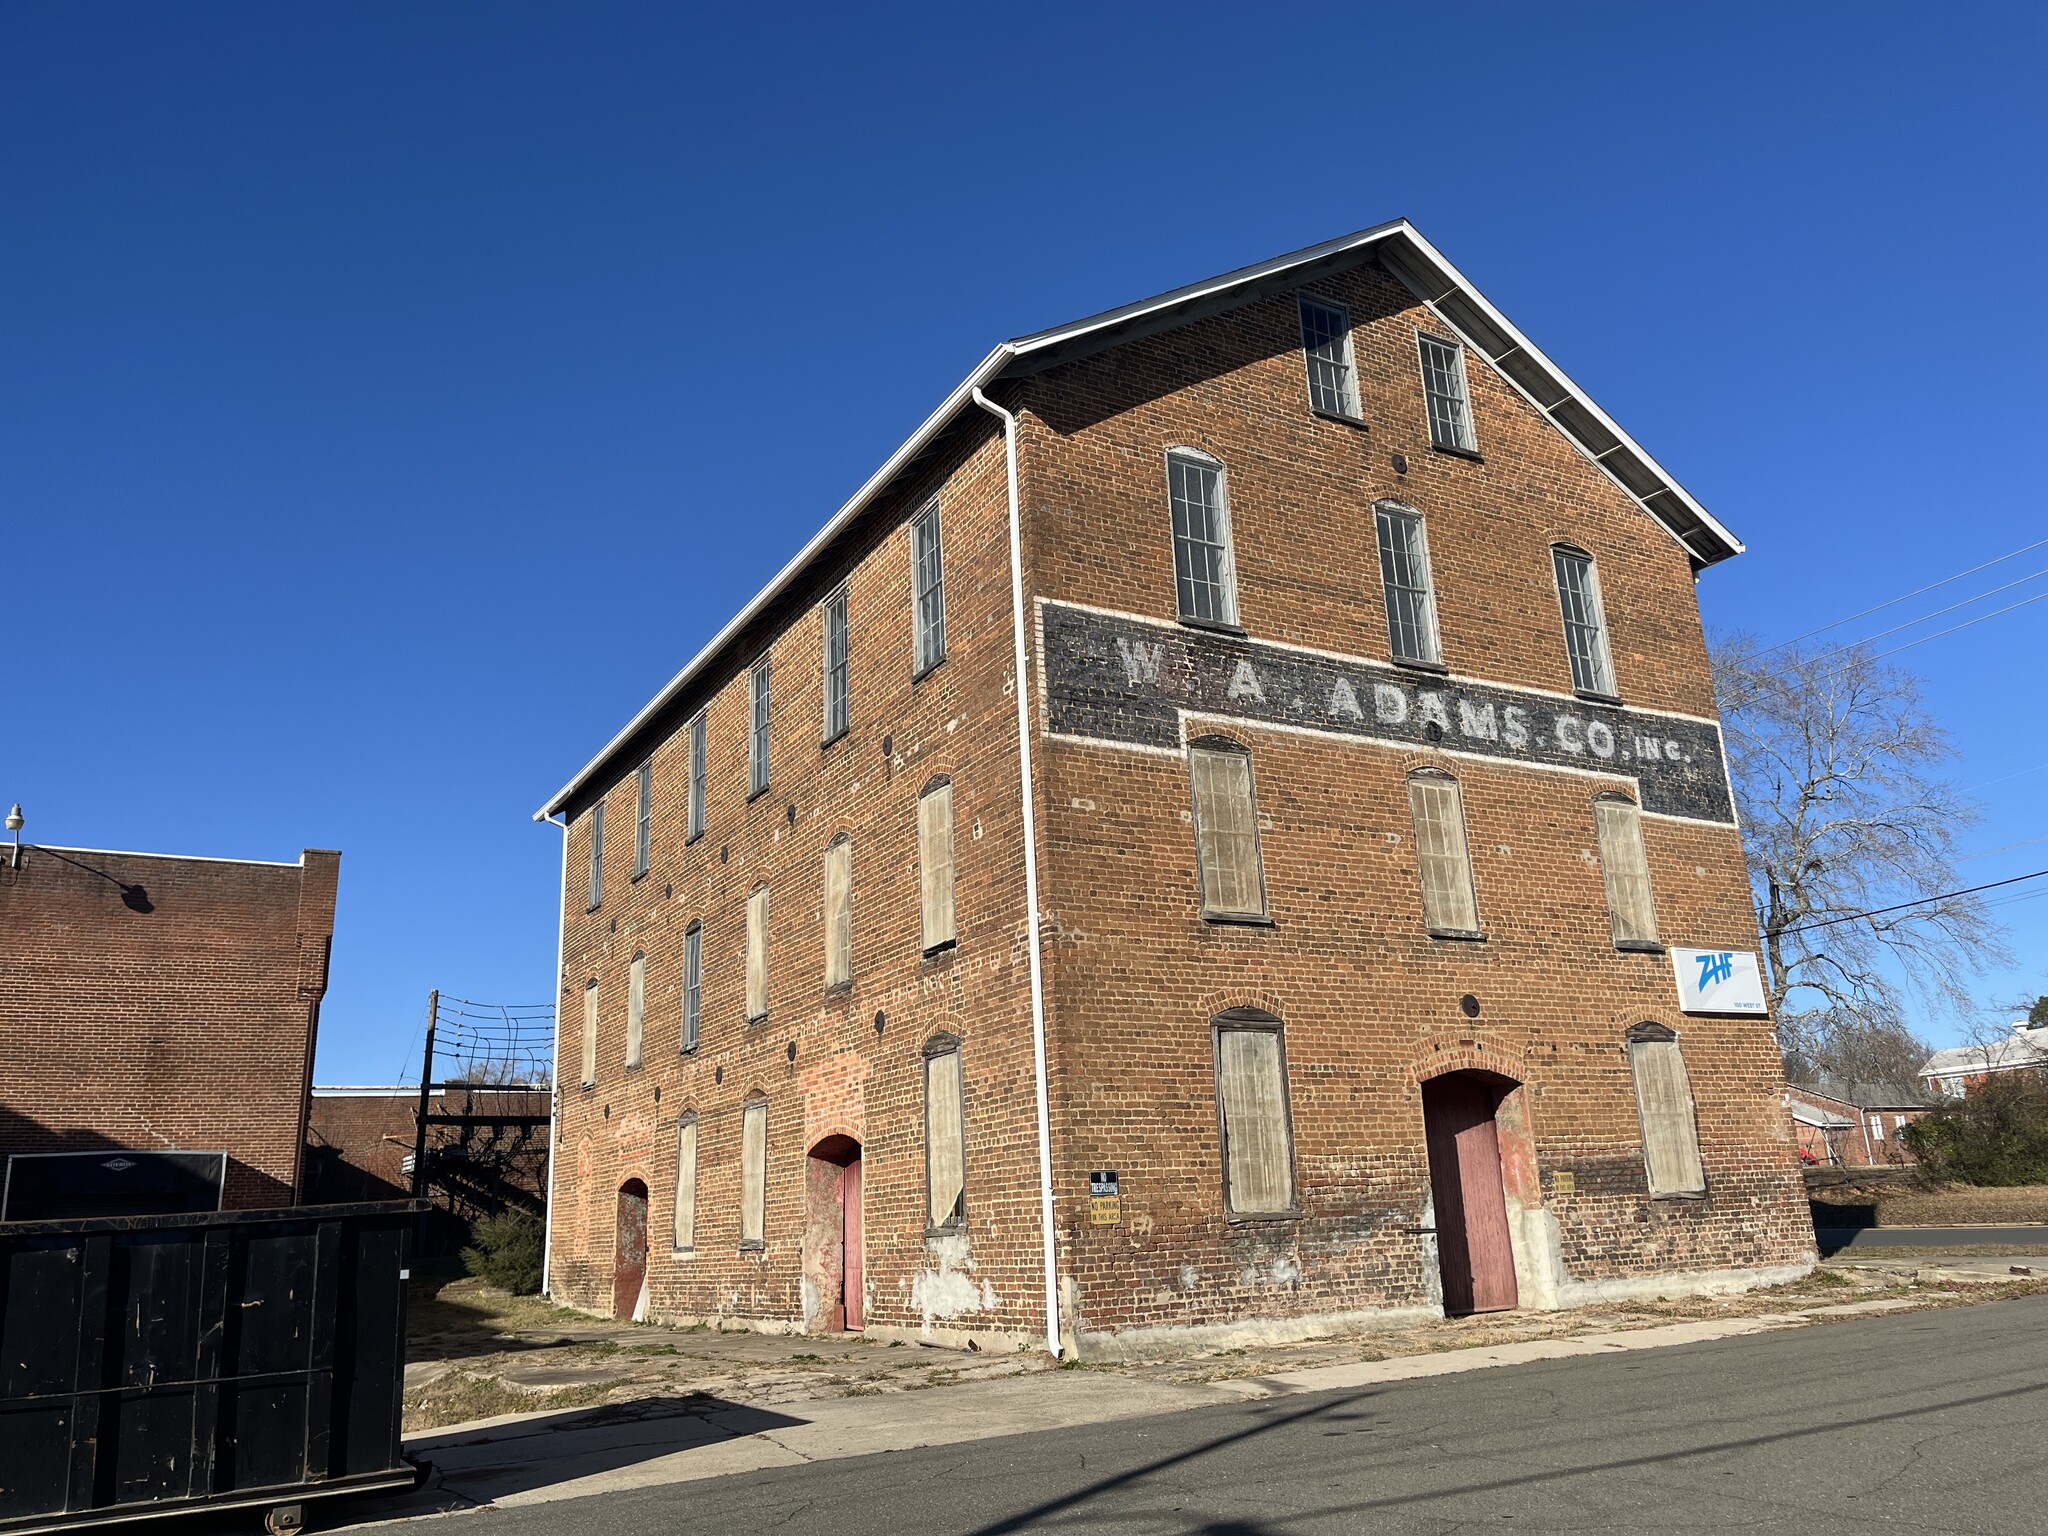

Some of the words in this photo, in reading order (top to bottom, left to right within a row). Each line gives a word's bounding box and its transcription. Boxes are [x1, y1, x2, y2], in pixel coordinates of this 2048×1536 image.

[1695, 952, 1734, 994] ZHF
[1100, 1172, 1107, 1182] NO
[1091, 1182, 1117, 1193] TRESPASSING
[1091, 1202, 1098, 1211] NO
[1100, 1200, 1119, 1211] PARKING
[1092, 1213, 1097, 1221] IN
[1098, 1212, 1107, 1221] THIS
[1109, 1212, 1119, 1220] AREA
